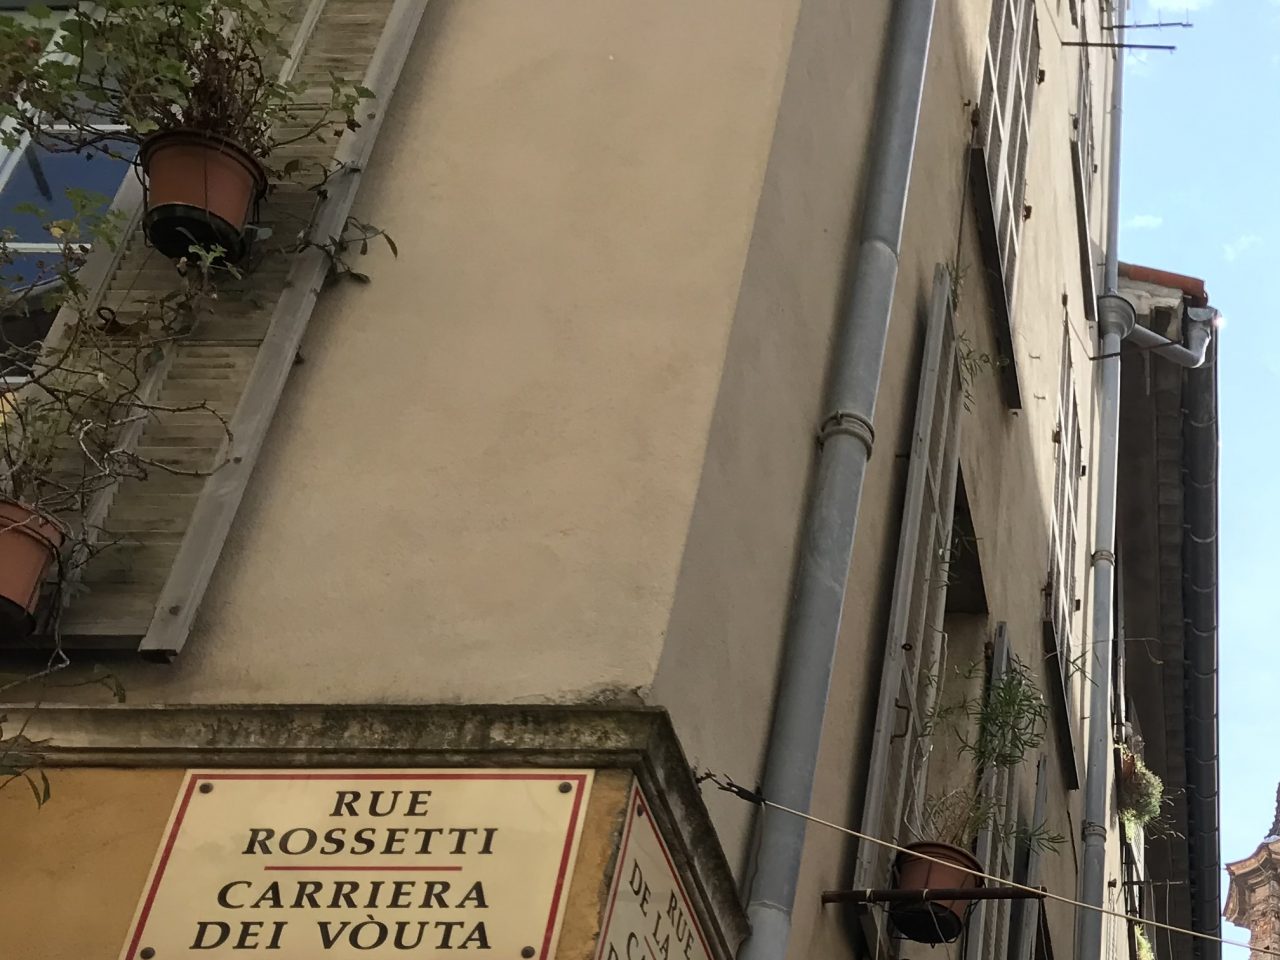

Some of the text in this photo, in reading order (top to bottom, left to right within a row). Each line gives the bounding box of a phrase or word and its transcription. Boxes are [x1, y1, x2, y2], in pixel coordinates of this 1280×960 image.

[329, 790, 432, 817] RUE
[241, 827, 498, 856] ROSSETTI
[217, 880, 489, 909] CARRIERA
[629, 858, 651, 917] DE
[188, 914, 492, 950] DEI VÒUTA
